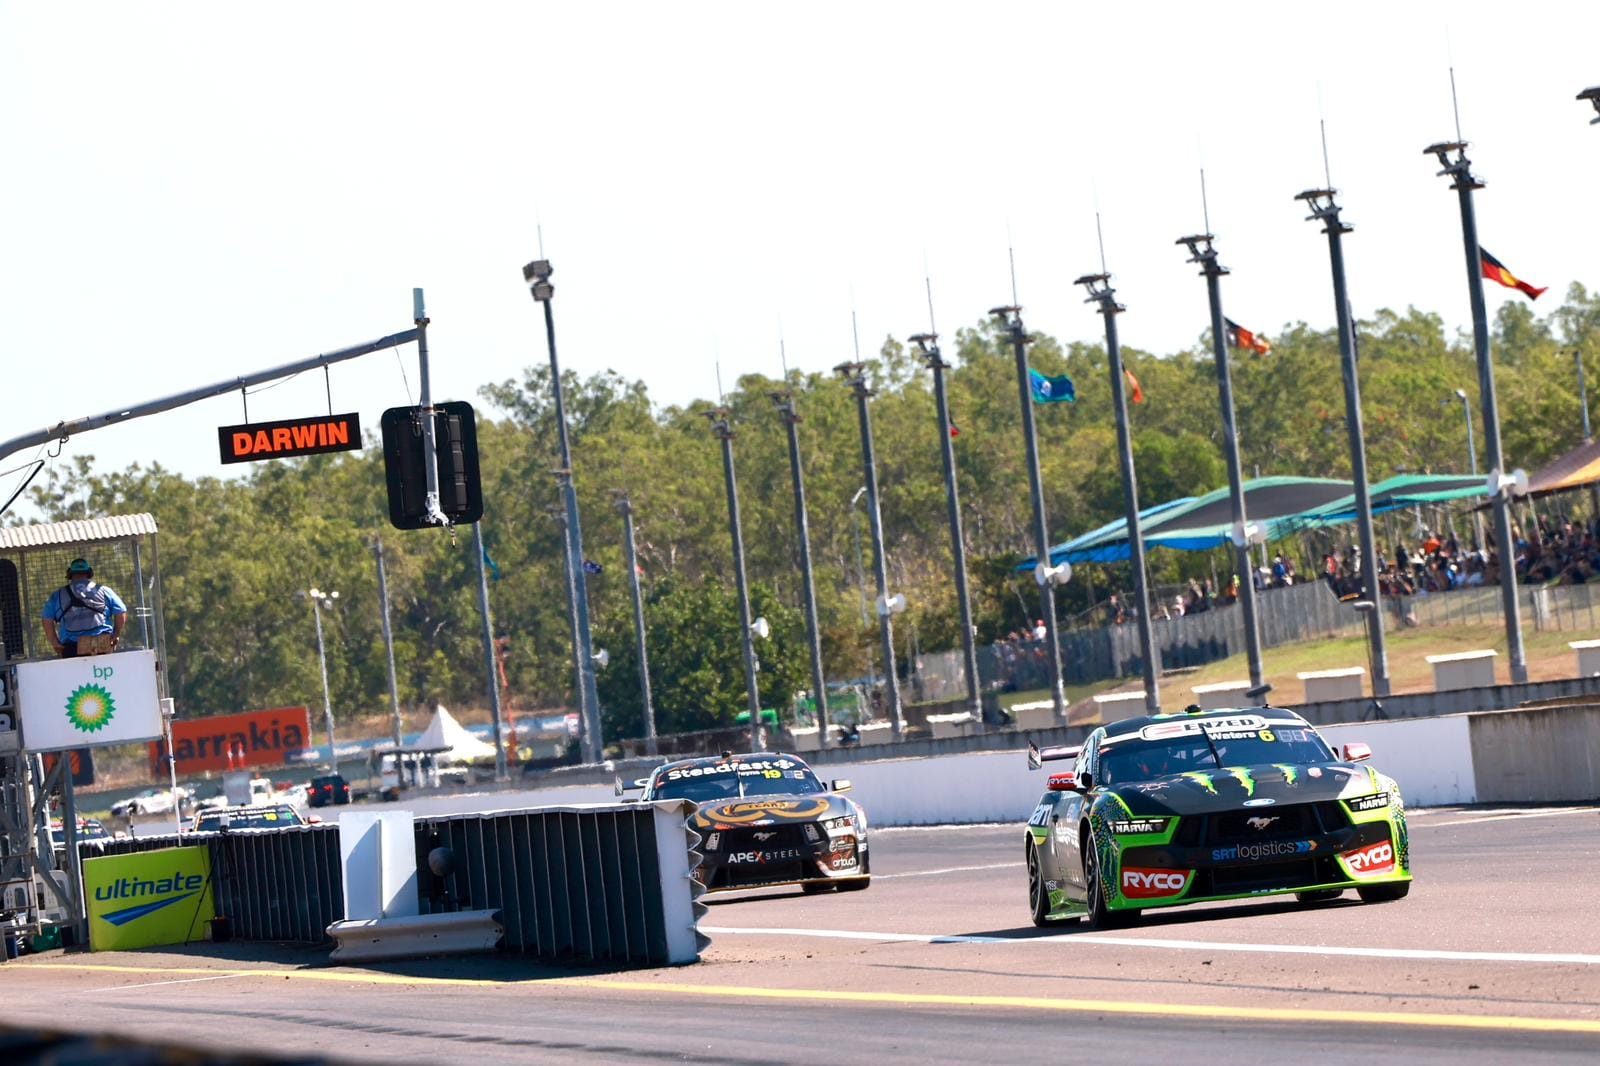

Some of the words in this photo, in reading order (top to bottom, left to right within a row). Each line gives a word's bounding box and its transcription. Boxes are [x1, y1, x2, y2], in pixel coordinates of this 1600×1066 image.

[232, 421, 349, 456] DARWIN
[93, 665, 114, 680] bp
[1184, 719, 1255, 731] ENZED
[1208, 730, 1257, 741] Waters
[1258, 730, 1275, 742] 6
[668, 760, 772, 780] Steadfast
[761, 769, 782, 780] 19
[1359, 797, 1388, 810] NARVA
[1116, 821, 1153, 833] NARVA
[728, 850, 766, 865] APEX
[766, 849, 801, 862] STEEL
[1346, 843, 1393, 872] RYCO
[95, 871, 203, 901] ultimate
[1123, 871, 1185, 889] RYCO
